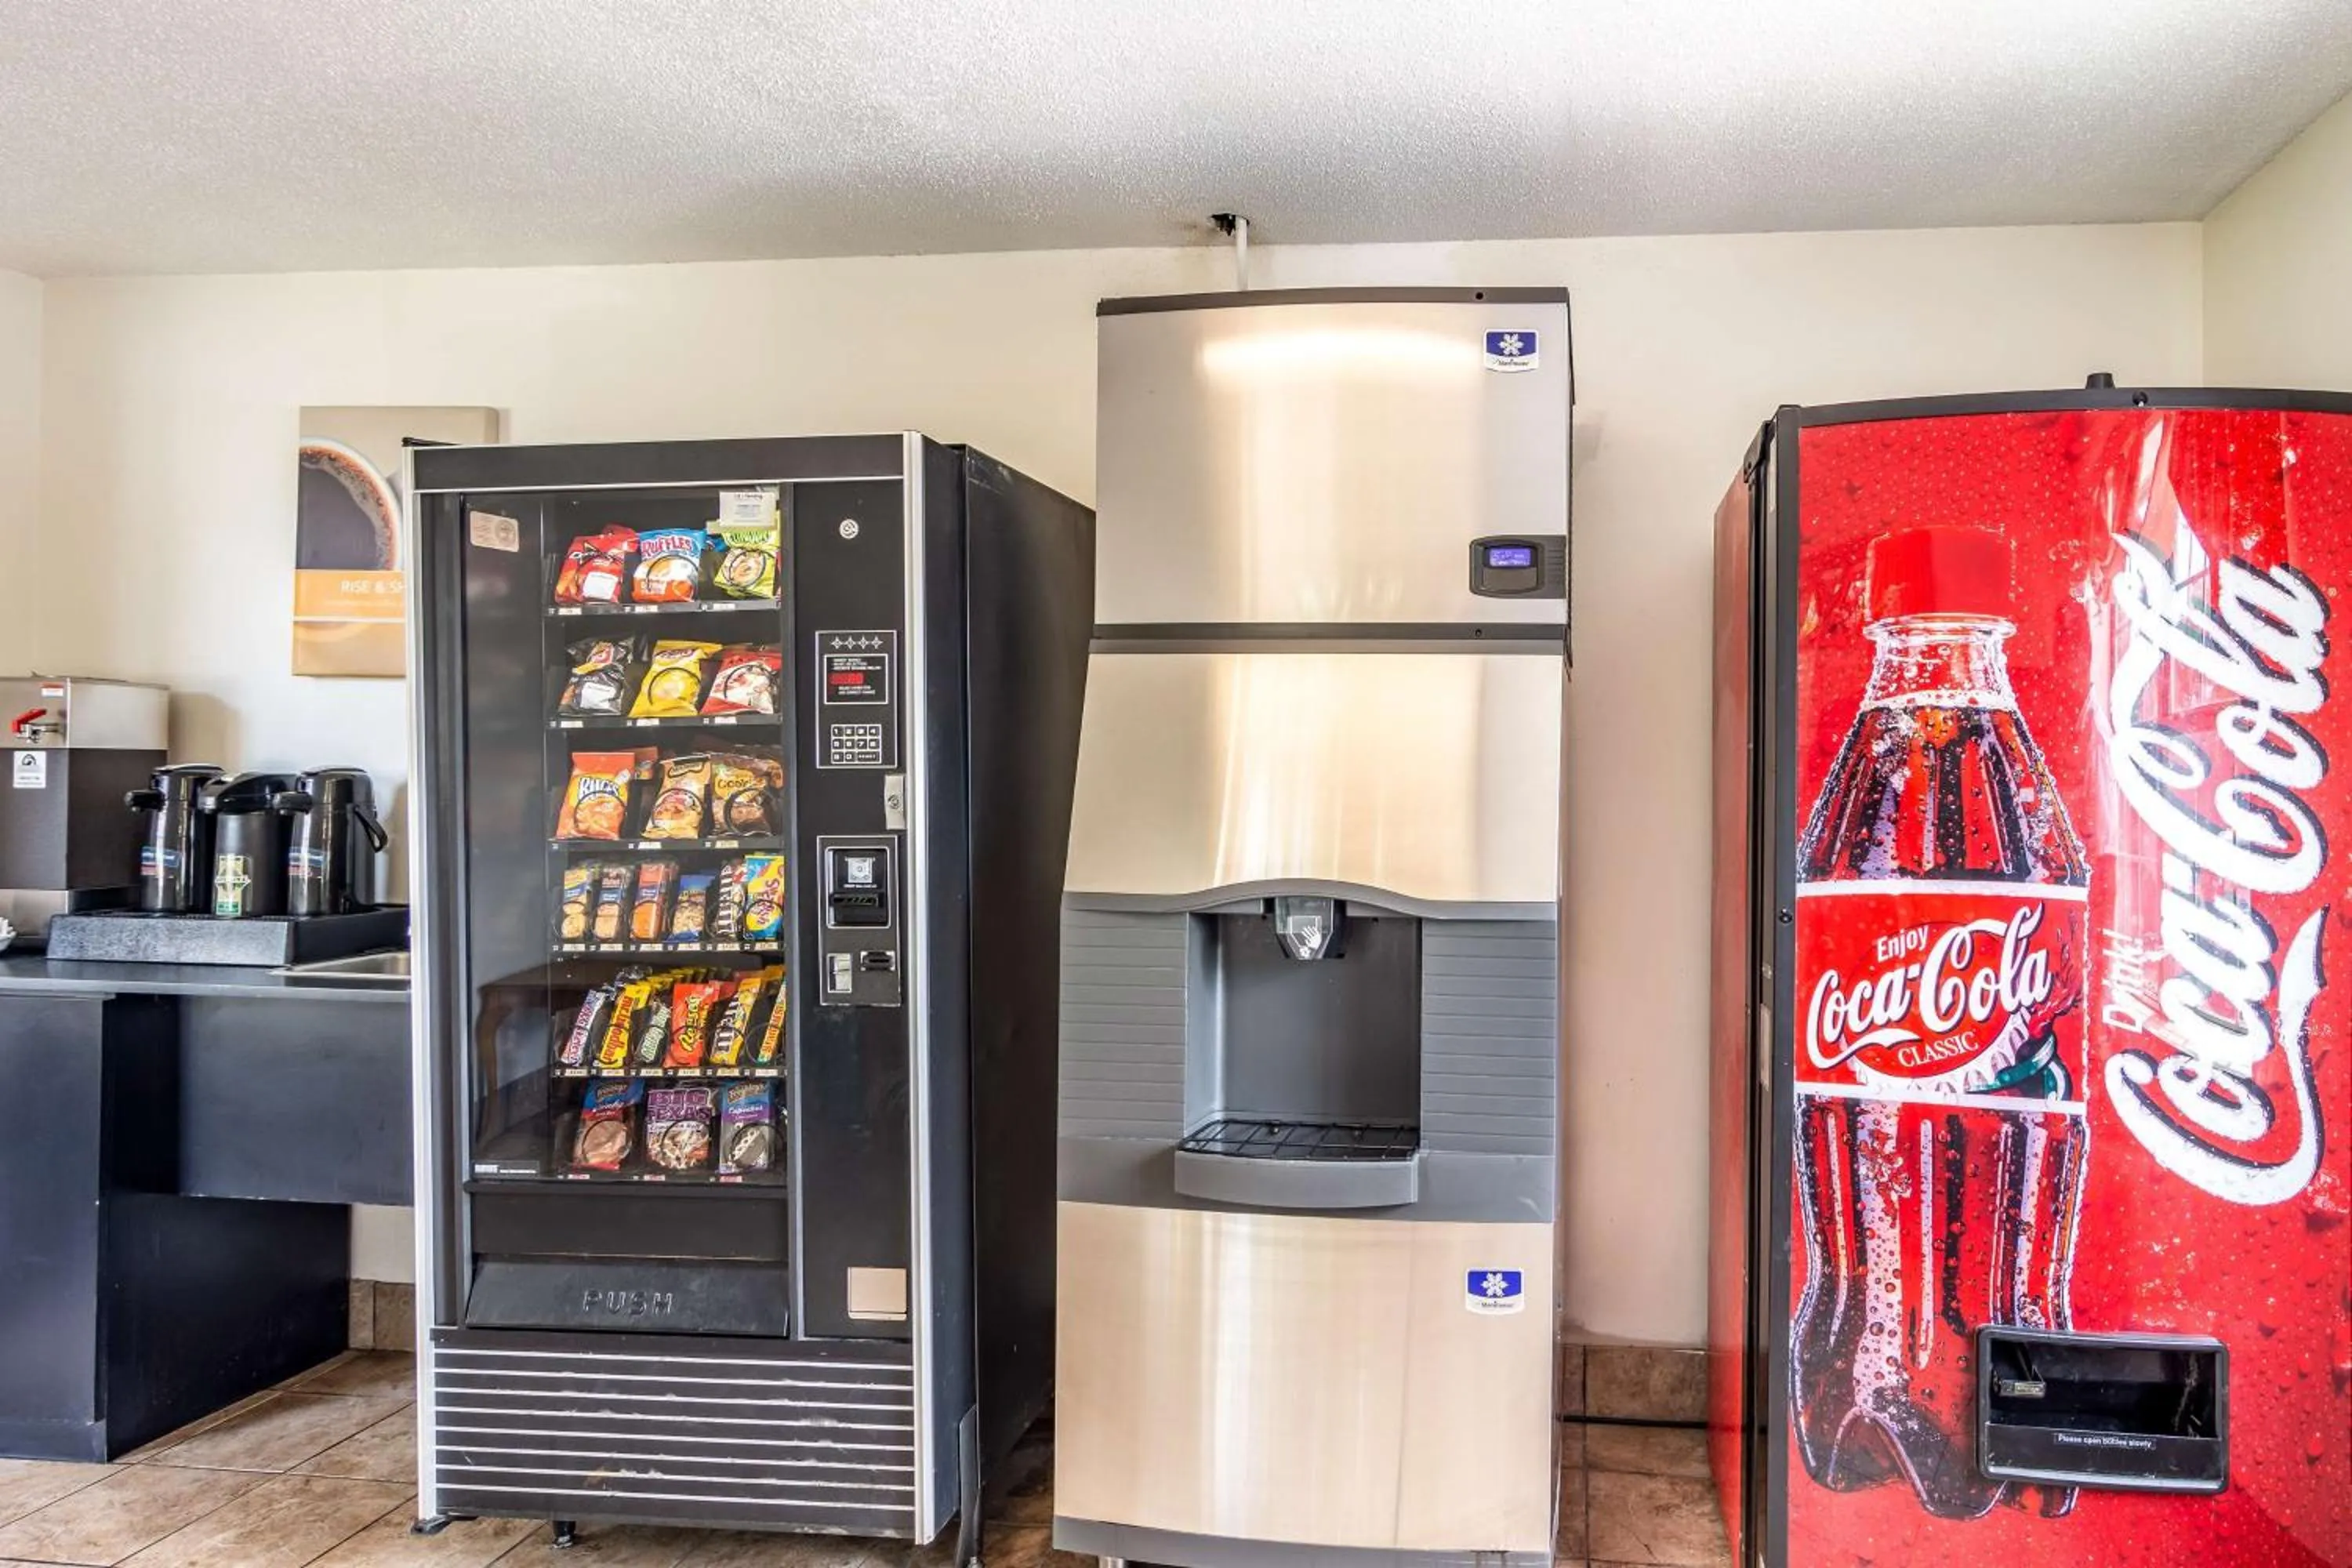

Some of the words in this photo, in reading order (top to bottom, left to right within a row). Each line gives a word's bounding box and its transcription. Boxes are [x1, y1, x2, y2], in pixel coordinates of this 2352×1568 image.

[641, 535, 692, 556] RUFFLES
[341, 580, 368, 593] RISE
[2104, 532, 2330, 1207] Coca-Cola
[1875, 926, 1929, 964] Enjoy
[1806, 901, 2052, 1070] Coca-Cola
[1897, 1031, 1980, 1069] CLASSIC
[583, 1291, 673, 1317] PUSH
[2058, 1433, 2082, 1444] Please
[2084, 1437, 2101, 1446] open
[2129, 1439, 2152, 1450] slowly
